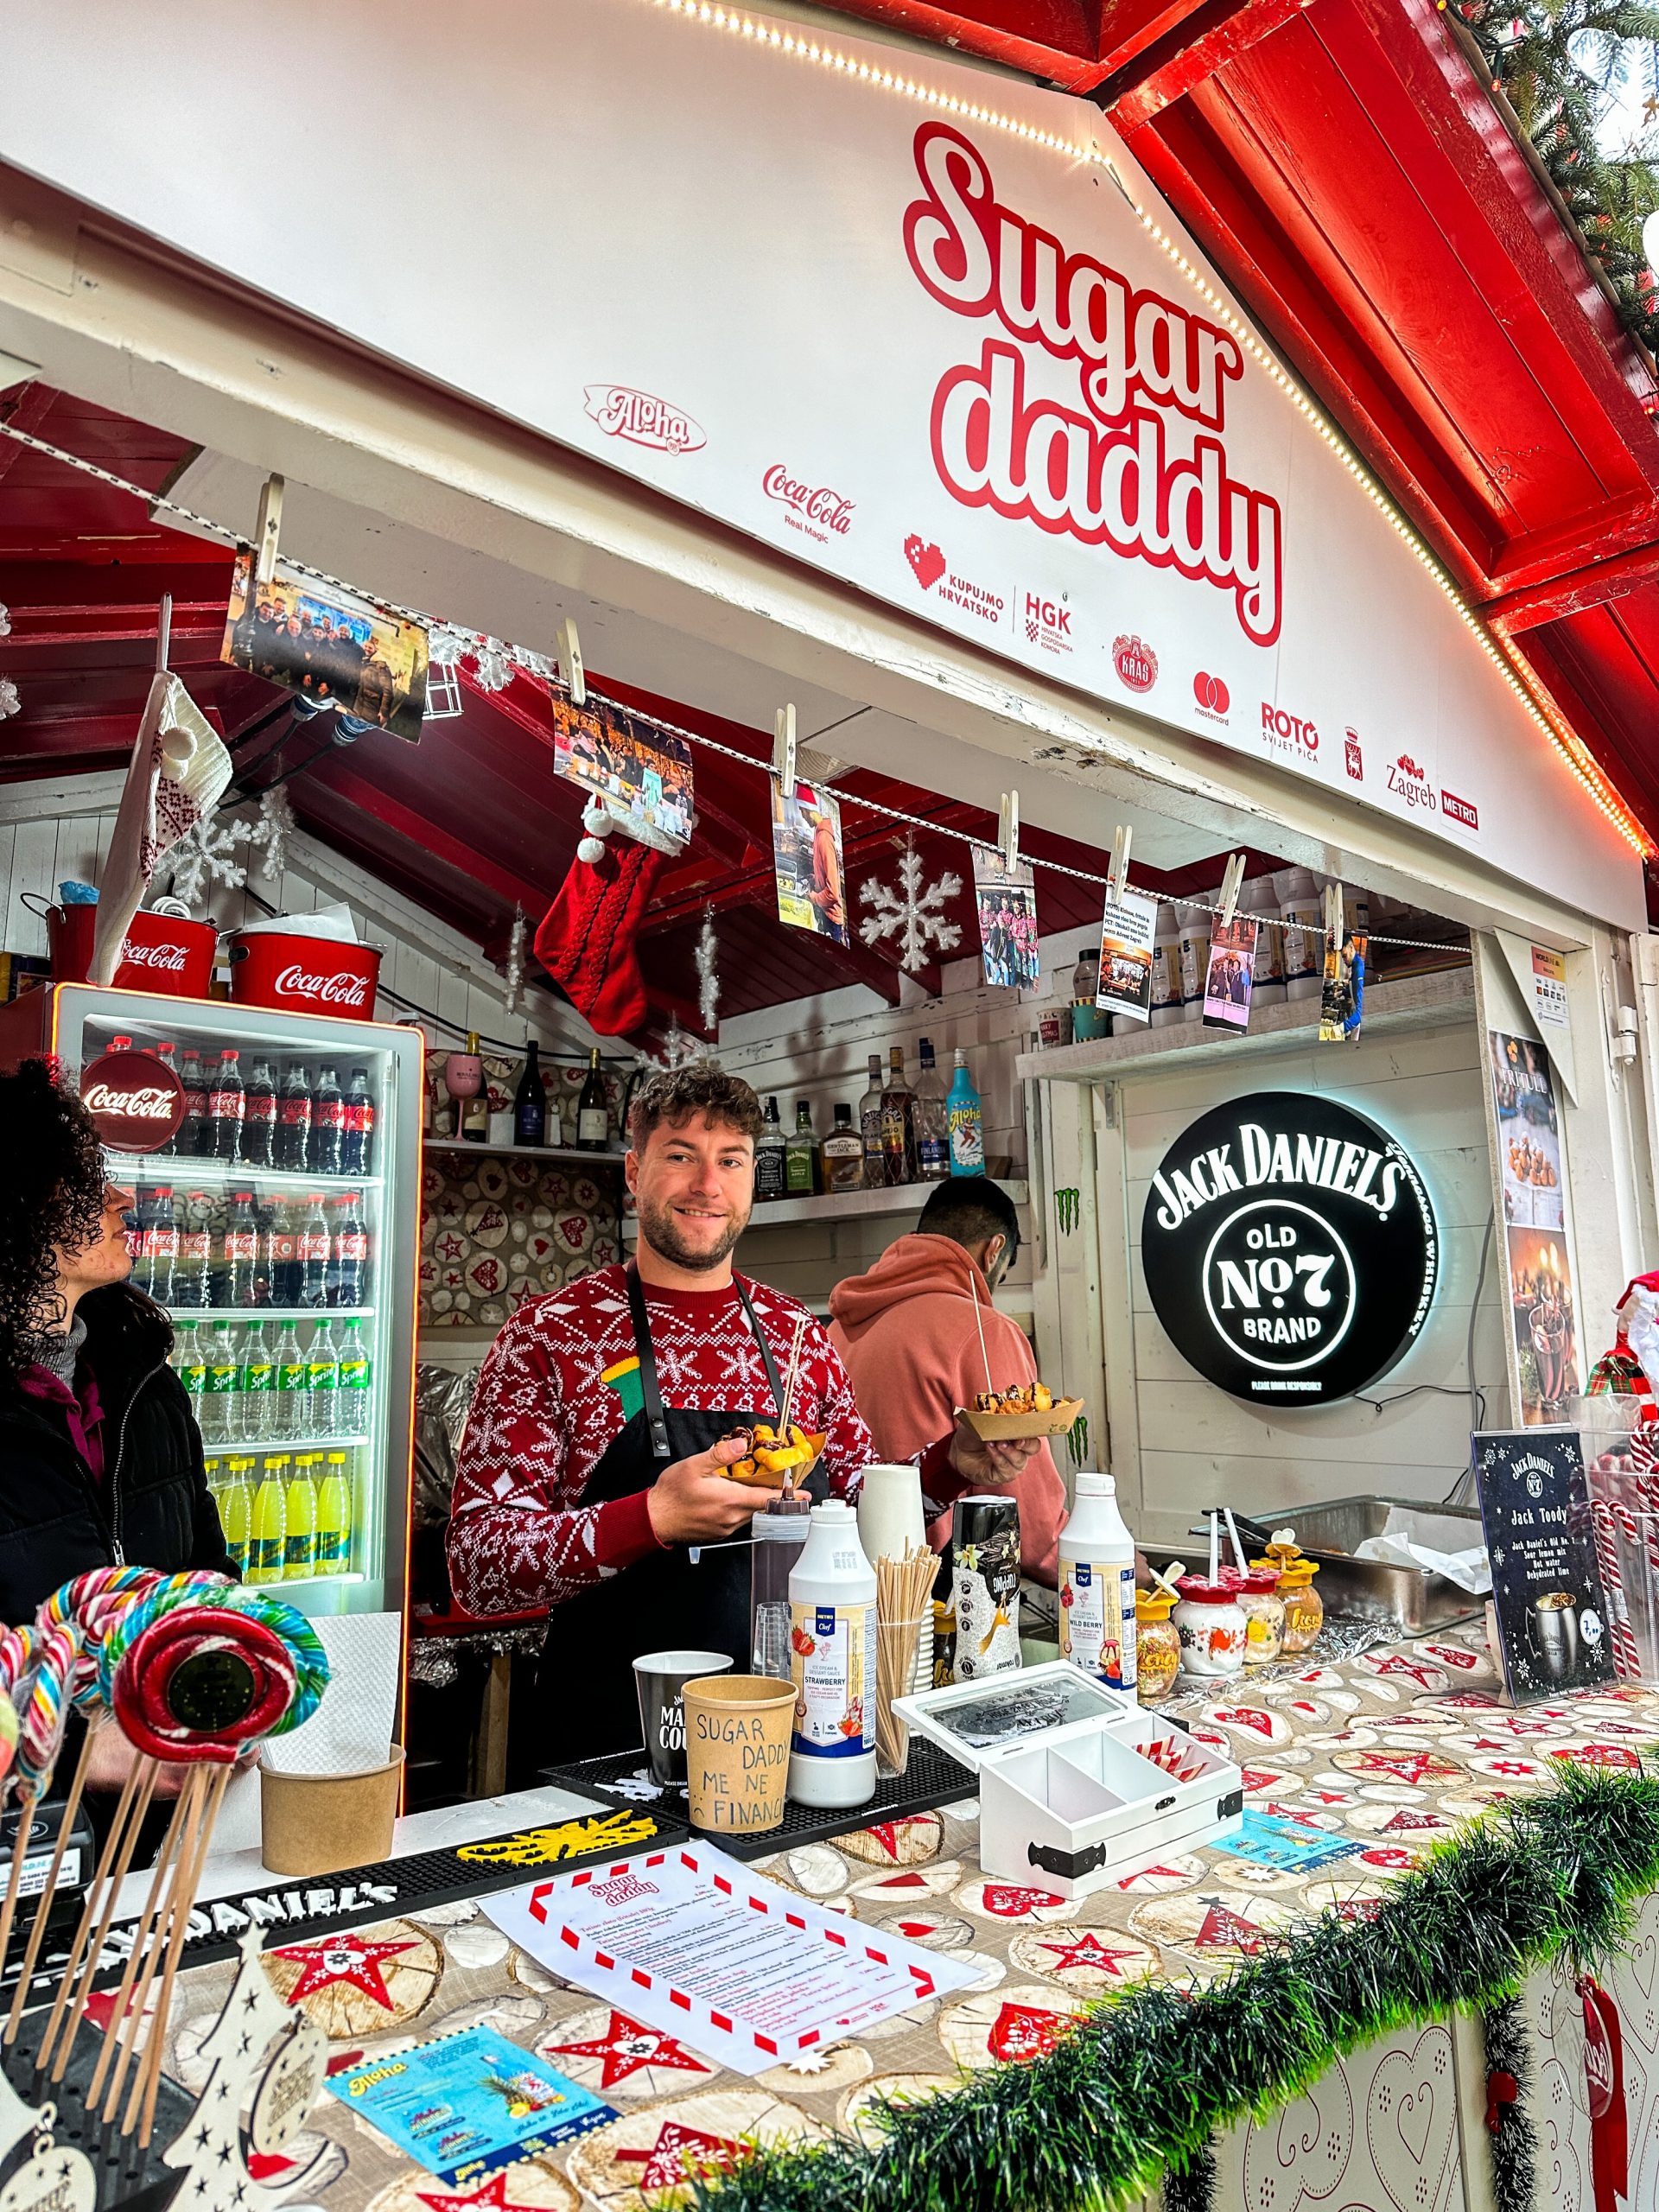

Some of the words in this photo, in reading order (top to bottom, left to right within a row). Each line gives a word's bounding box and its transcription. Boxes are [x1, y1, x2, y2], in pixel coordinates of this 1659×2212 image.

[903, 121, 1244, 432] Sugar
[597, 389, 690, 443] Aloha
[763, 464, 856, 534] Coca-Cola
[931, 338, 1281, 647] daddy
[784, 515, 803, 531] Real
[804, 523, 829, 543] Magic
[938, 585, 998, 623] HRVATSKO
[950, 574, 1004, 610] KUPUJMO
[1026, 592, 1071, 635] HGK
[1195, 707, 1230, 726] mastercard
[1261, 702, 1319, 750] ROTO
[1262, 732, 1293, 753] SVIJET
[1387, 765, 1436, 810] Zagreb
[1443, 797, 1477, 823] METRO
[275, 965, 371, 1007] Coca-Cola
[84, 1084, 178, 1120] Coca-Cola
[950, 1107, 981, 1133] Aloha
[1152, 1142, 1244, 1230] JACK
[1387, 1141, 1433, 1236] Tennessee
[1246, 1224, 1297, 1250] OLD
[1408, 1239, 1435, 1337] WHISKEY
[1243, 1317, 1321, 1344] BRAND
[1510, 1457, 1529, 1480] JACK
[1511, 1508, 1535, 1526] Jack
[1539, 1505, 1567, 1525] Toody
[1511, 1541, 1524, 1551] Jack
[1526, 1537, 1548, 1549] Daniel's
[1549, 1536, 1559, 1547] Old
[1523, 1550, 1536, 1560] Sour
[1538, 1548, 1554, 1558] lemon
[1556, 1547, 1567, 1556] mix
[1526, 1567, 1555, 1581] Dehydrated
[1557, 1567, 1570, 1576] lime
[1533, 1560, 1543, 1569] Hot
[1545, 1558, 1560, 1567] water
[994, 1573, 1016, 1593] TOPPING
[1077, 1575, 1089, 1584] Chef
[818, 1623, 831, 1632] Chef
[804, 1676, 846, 1686] STRAWBERRY
[696, 1713, 766, 1745] SUGAR
[742, 1738, 790, 1770] DADDY
[702, 1770, 730, 1795] ME
[746, 1774, 769, 1796] NE
[588, 1874, 636, 1897] Sugar
[606, 1880, 660, 1906] daddy
[348, 2062, 409, 2097] Aloha
